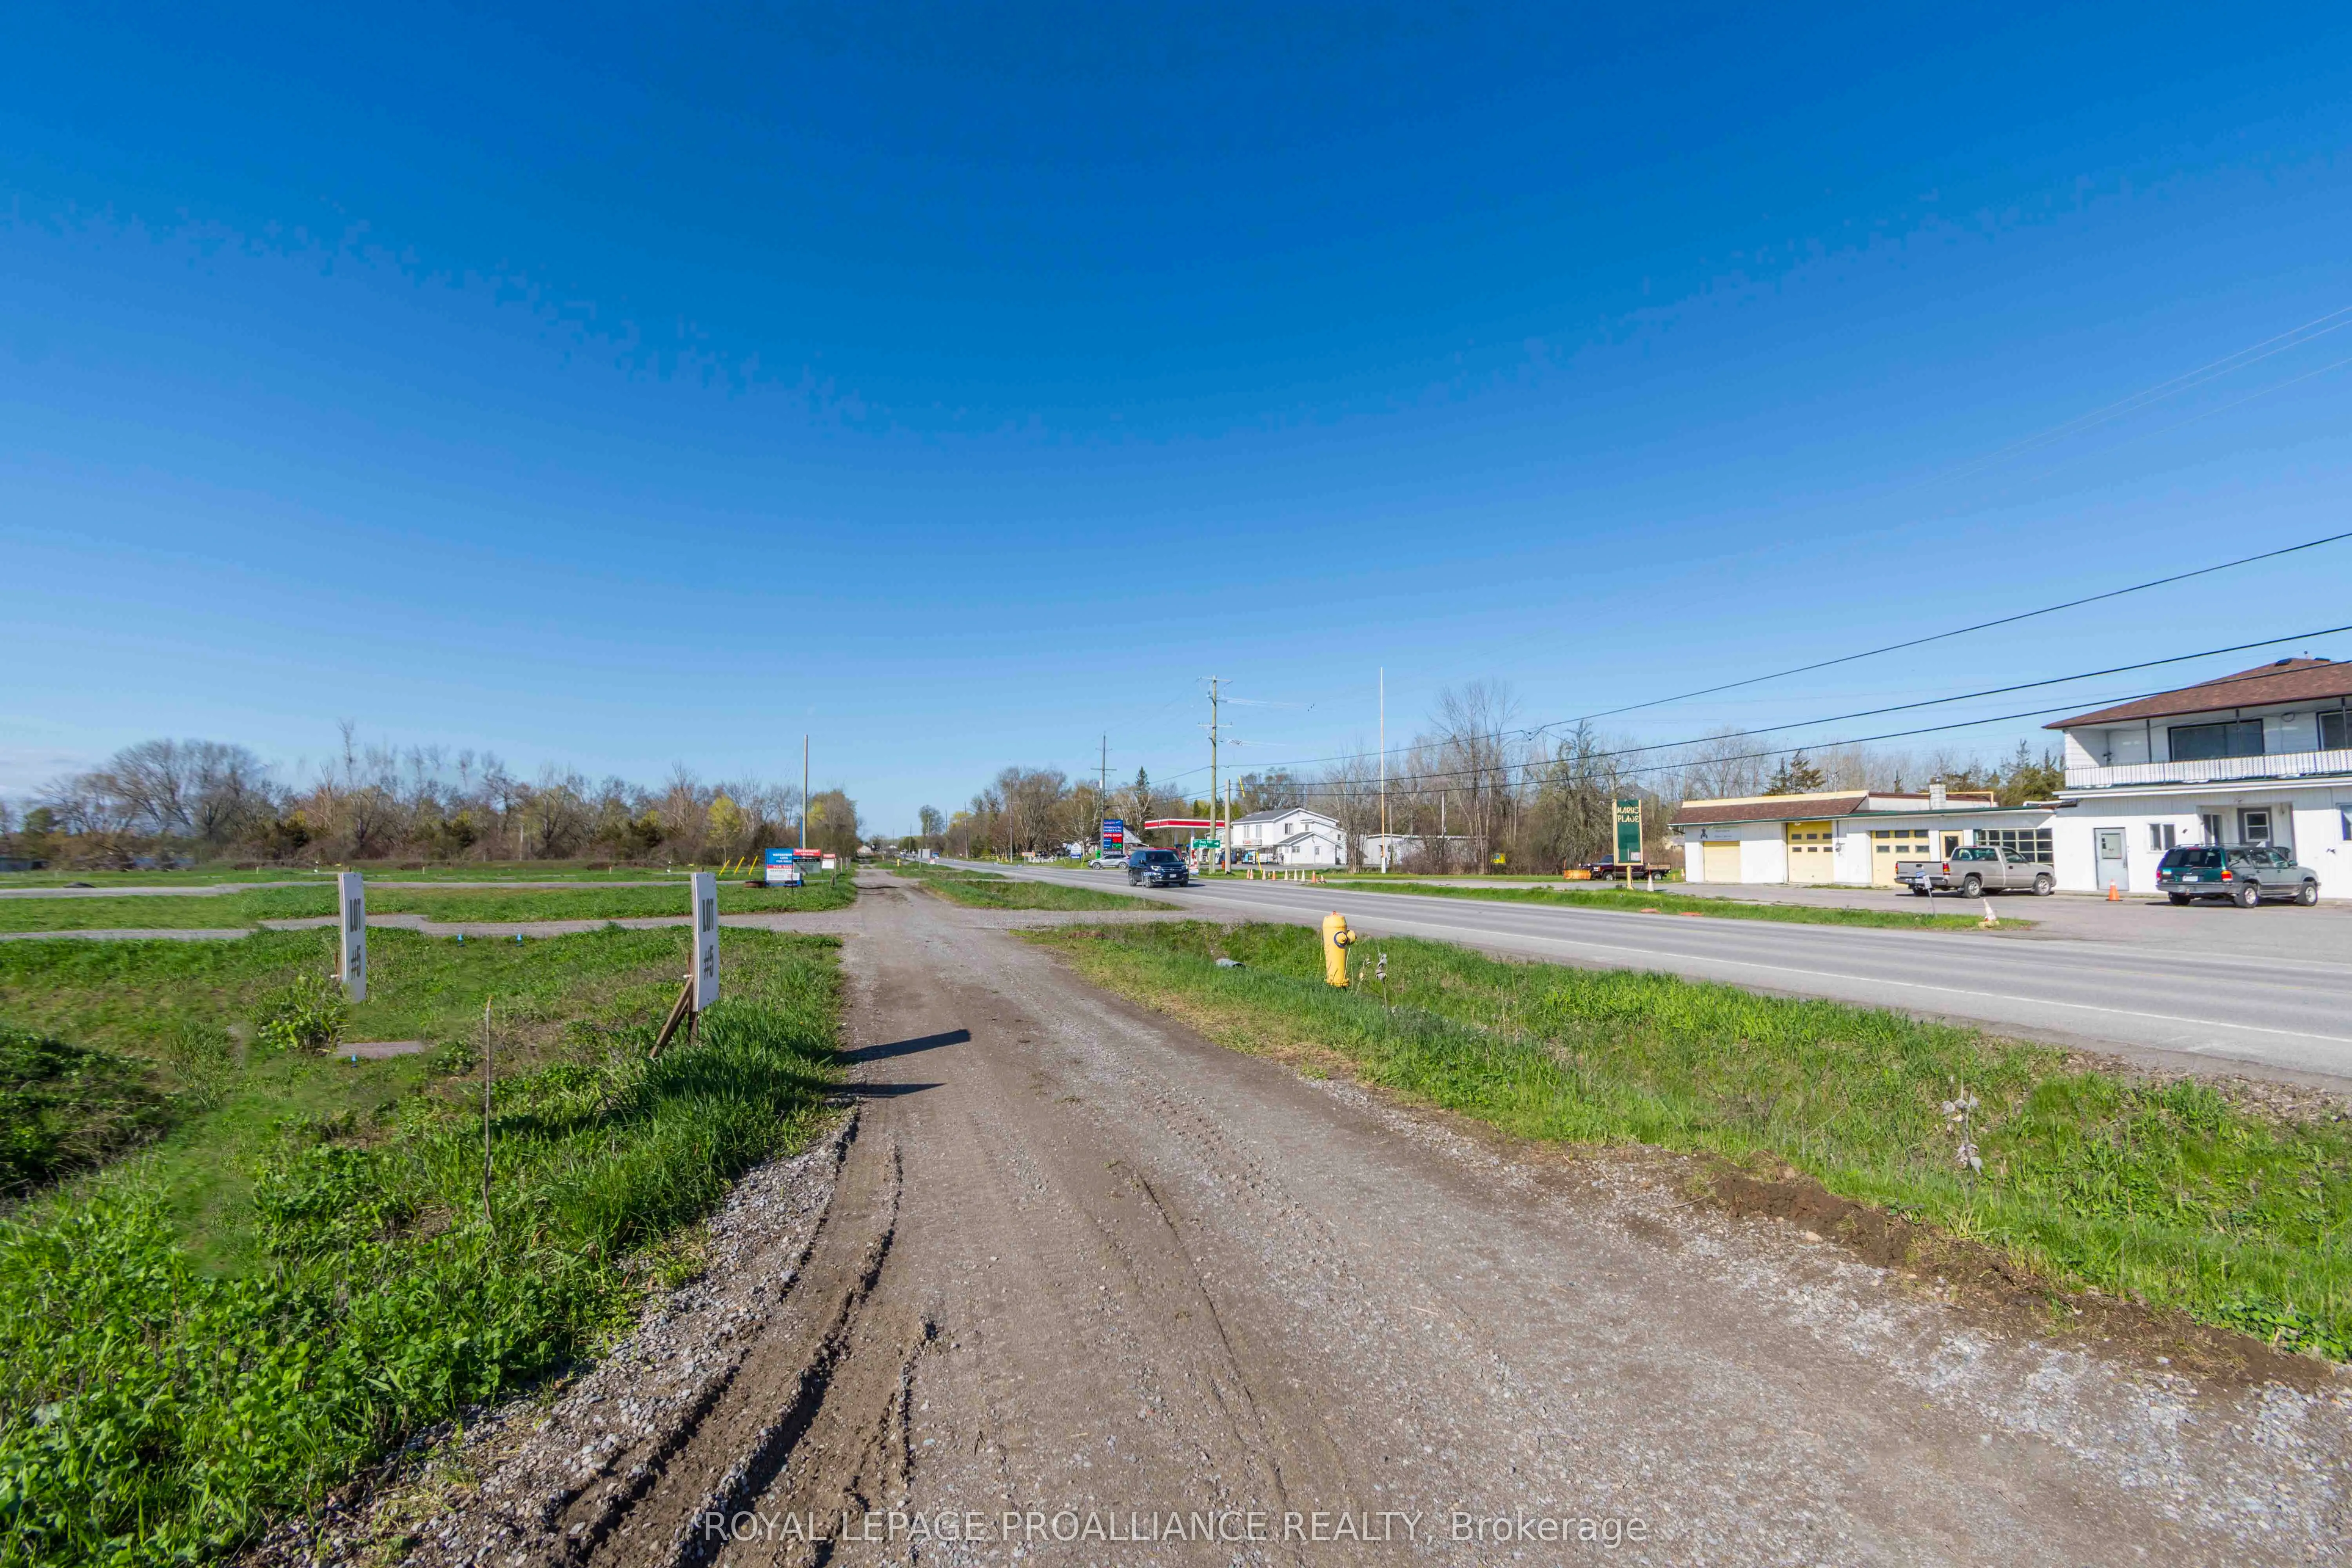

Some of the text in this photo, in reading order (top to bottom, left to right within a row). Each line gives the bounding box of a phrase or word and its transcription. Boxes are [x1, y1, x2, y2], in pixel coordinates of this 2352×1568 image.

[349, 898, 361, 933] LOT
[702, 898, 714, 933] LOT
[351, 944, 361, 980] #5
[704, 945, 714, 980] #5
